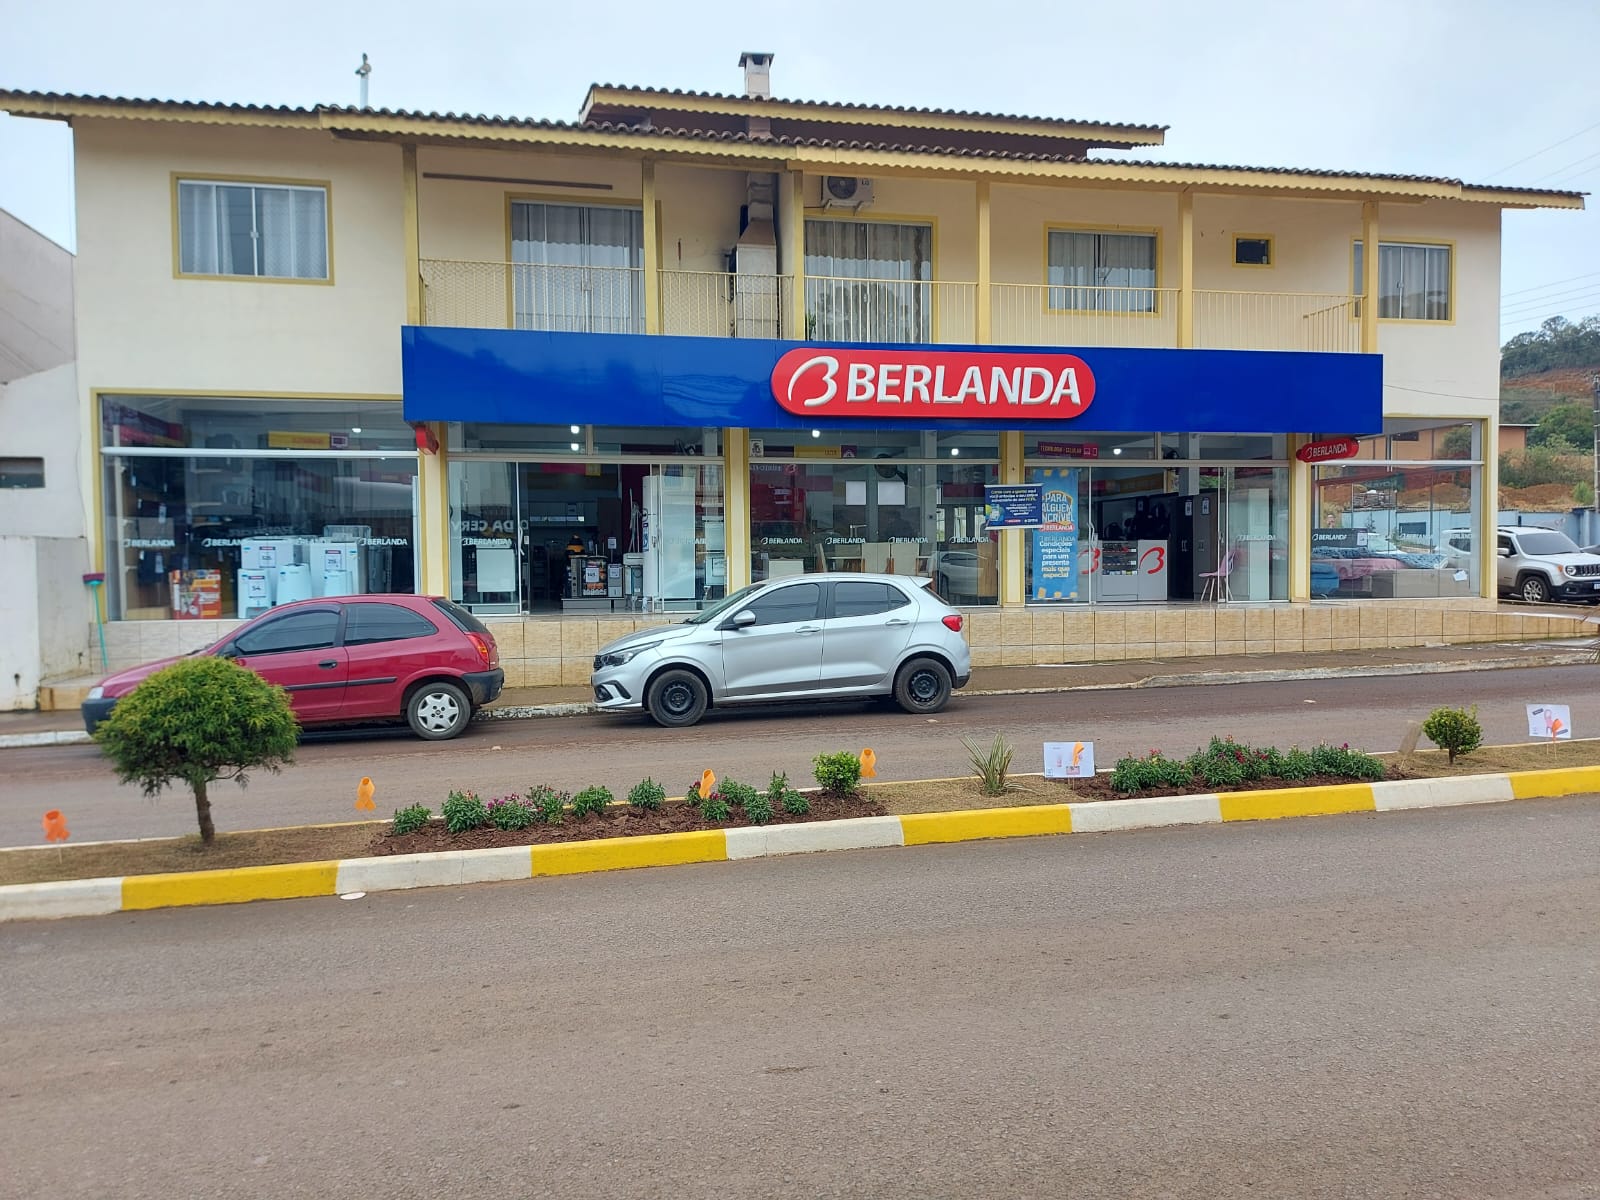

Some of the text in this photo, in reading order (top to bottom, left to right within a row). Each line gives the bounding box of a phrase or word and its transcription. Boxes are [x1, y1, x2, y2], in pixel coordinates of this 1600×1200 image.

[846, 362, 1081, 406] BERLANDA
[1312, 443, 1348, 457] BERLANDA
[1045, 492, 1067, 503] PARA
[1042, 511, 1074, 523] NCRÍVEL
[131, 538, 175, 547] BERLANDA
[212, 538, 242, 547] BERLAN
[367, 538, 408, 546] BERLANDA
[768, 537, 803, 545] BERLANDA
[1039, 541, 1073, 549] Condições
